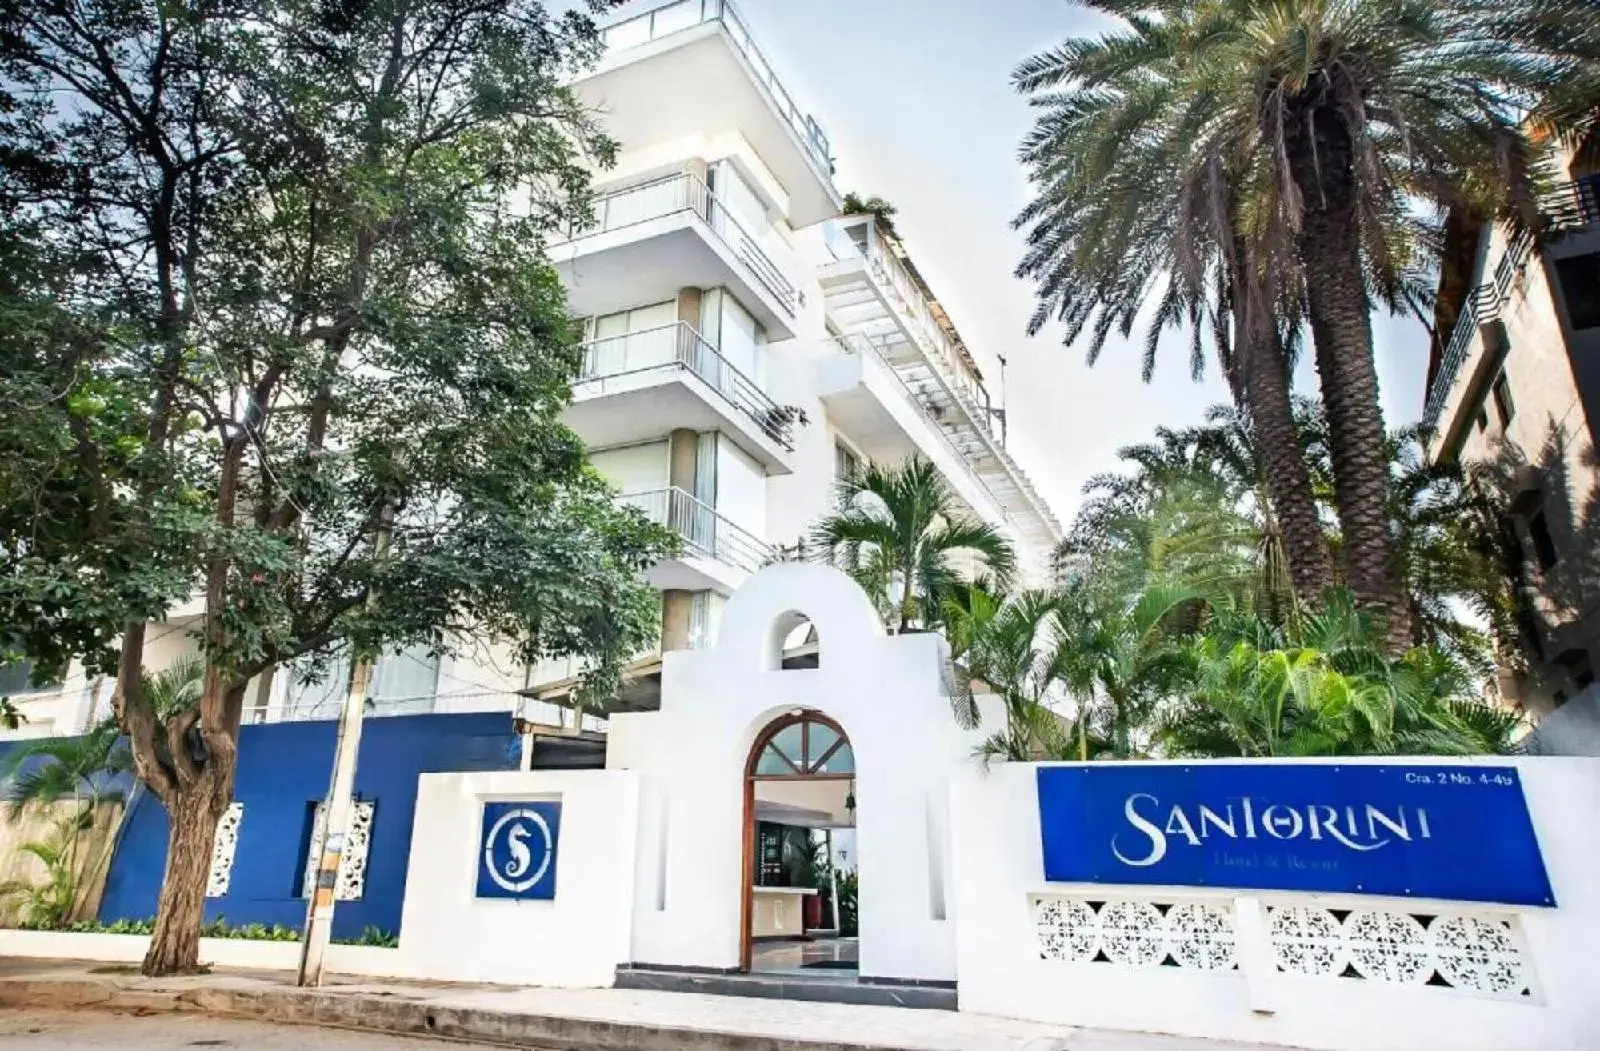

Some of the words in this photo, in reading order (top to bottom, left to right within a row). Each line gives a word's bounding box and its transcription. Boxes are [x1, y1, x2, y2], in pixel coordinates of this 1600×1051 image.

[1405, 772, 1435, 784] Cra.
[1437, 772, 1447, 785] 2
[1450, 772, 1476, 785] No.
